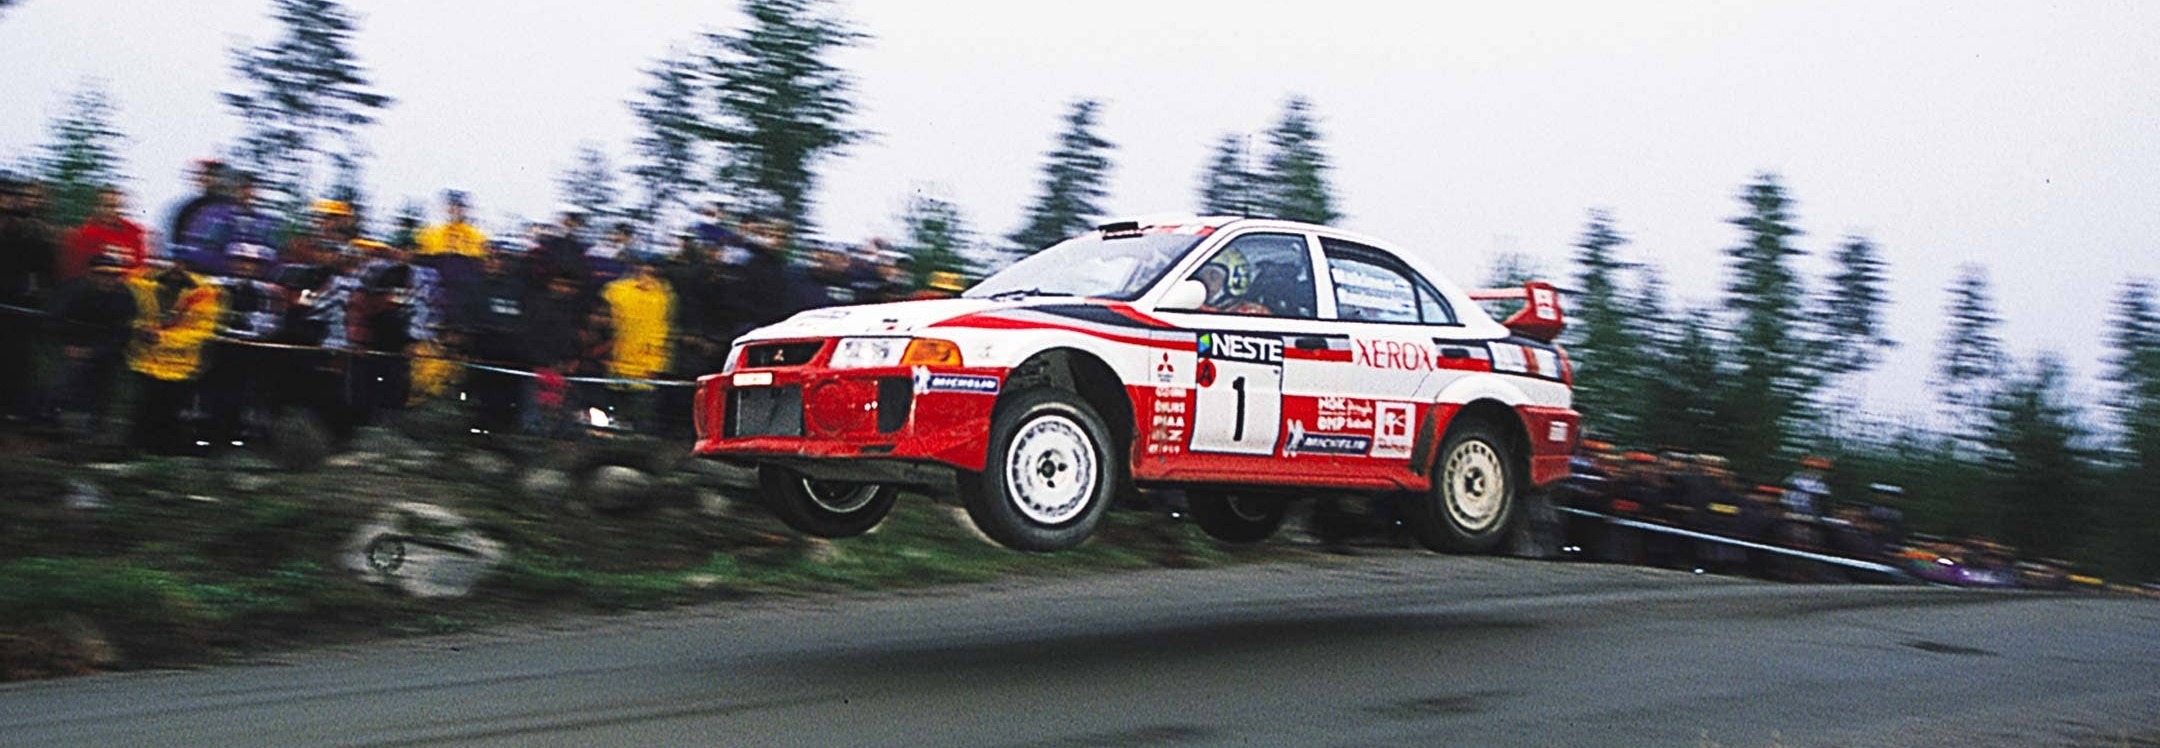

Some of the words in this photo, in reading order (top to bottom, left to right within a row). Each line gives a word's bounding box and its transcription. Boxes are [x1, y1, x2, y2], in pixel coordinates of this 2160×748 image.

[1211, 333, 1282, 361] NESTE
[1356, 339, 1434, 372] XEROX
[931, 377, 997, 389] MICHELIN
[1232, 376, 1245, 442] 1
[1153, 415, 1185, 427] PIAA
[1303, 437, 1368, 450] MICHELIN
